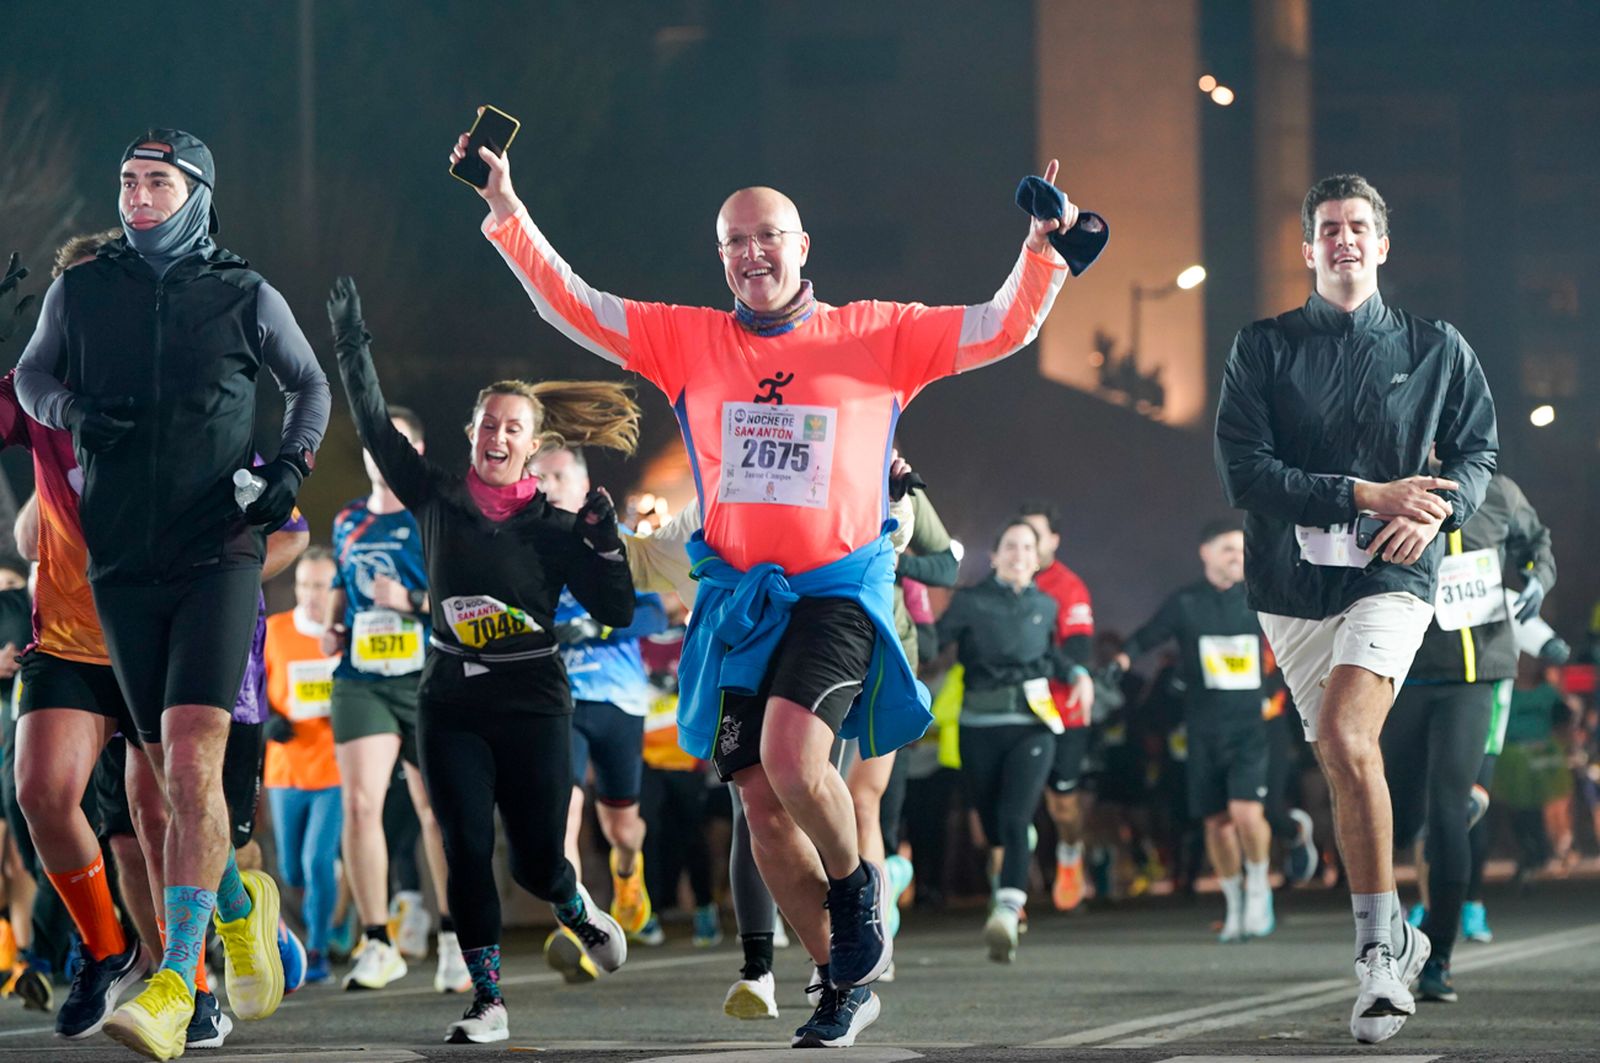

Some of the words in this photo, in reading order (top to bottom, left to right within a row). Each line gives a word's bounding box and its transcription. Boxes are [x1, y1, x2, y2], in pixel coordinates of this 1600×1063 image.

[746, 414, 780, 426] NOCHE
[781, 416, 795, 427] DE
[734, 425, 756, 437] SAN
[741, 438, 810, 473] 2675
[1441, 579, 1487, 604] 3149
[457, 611, 475, 622] SAN
[370, 635, 404, 653] 1571
